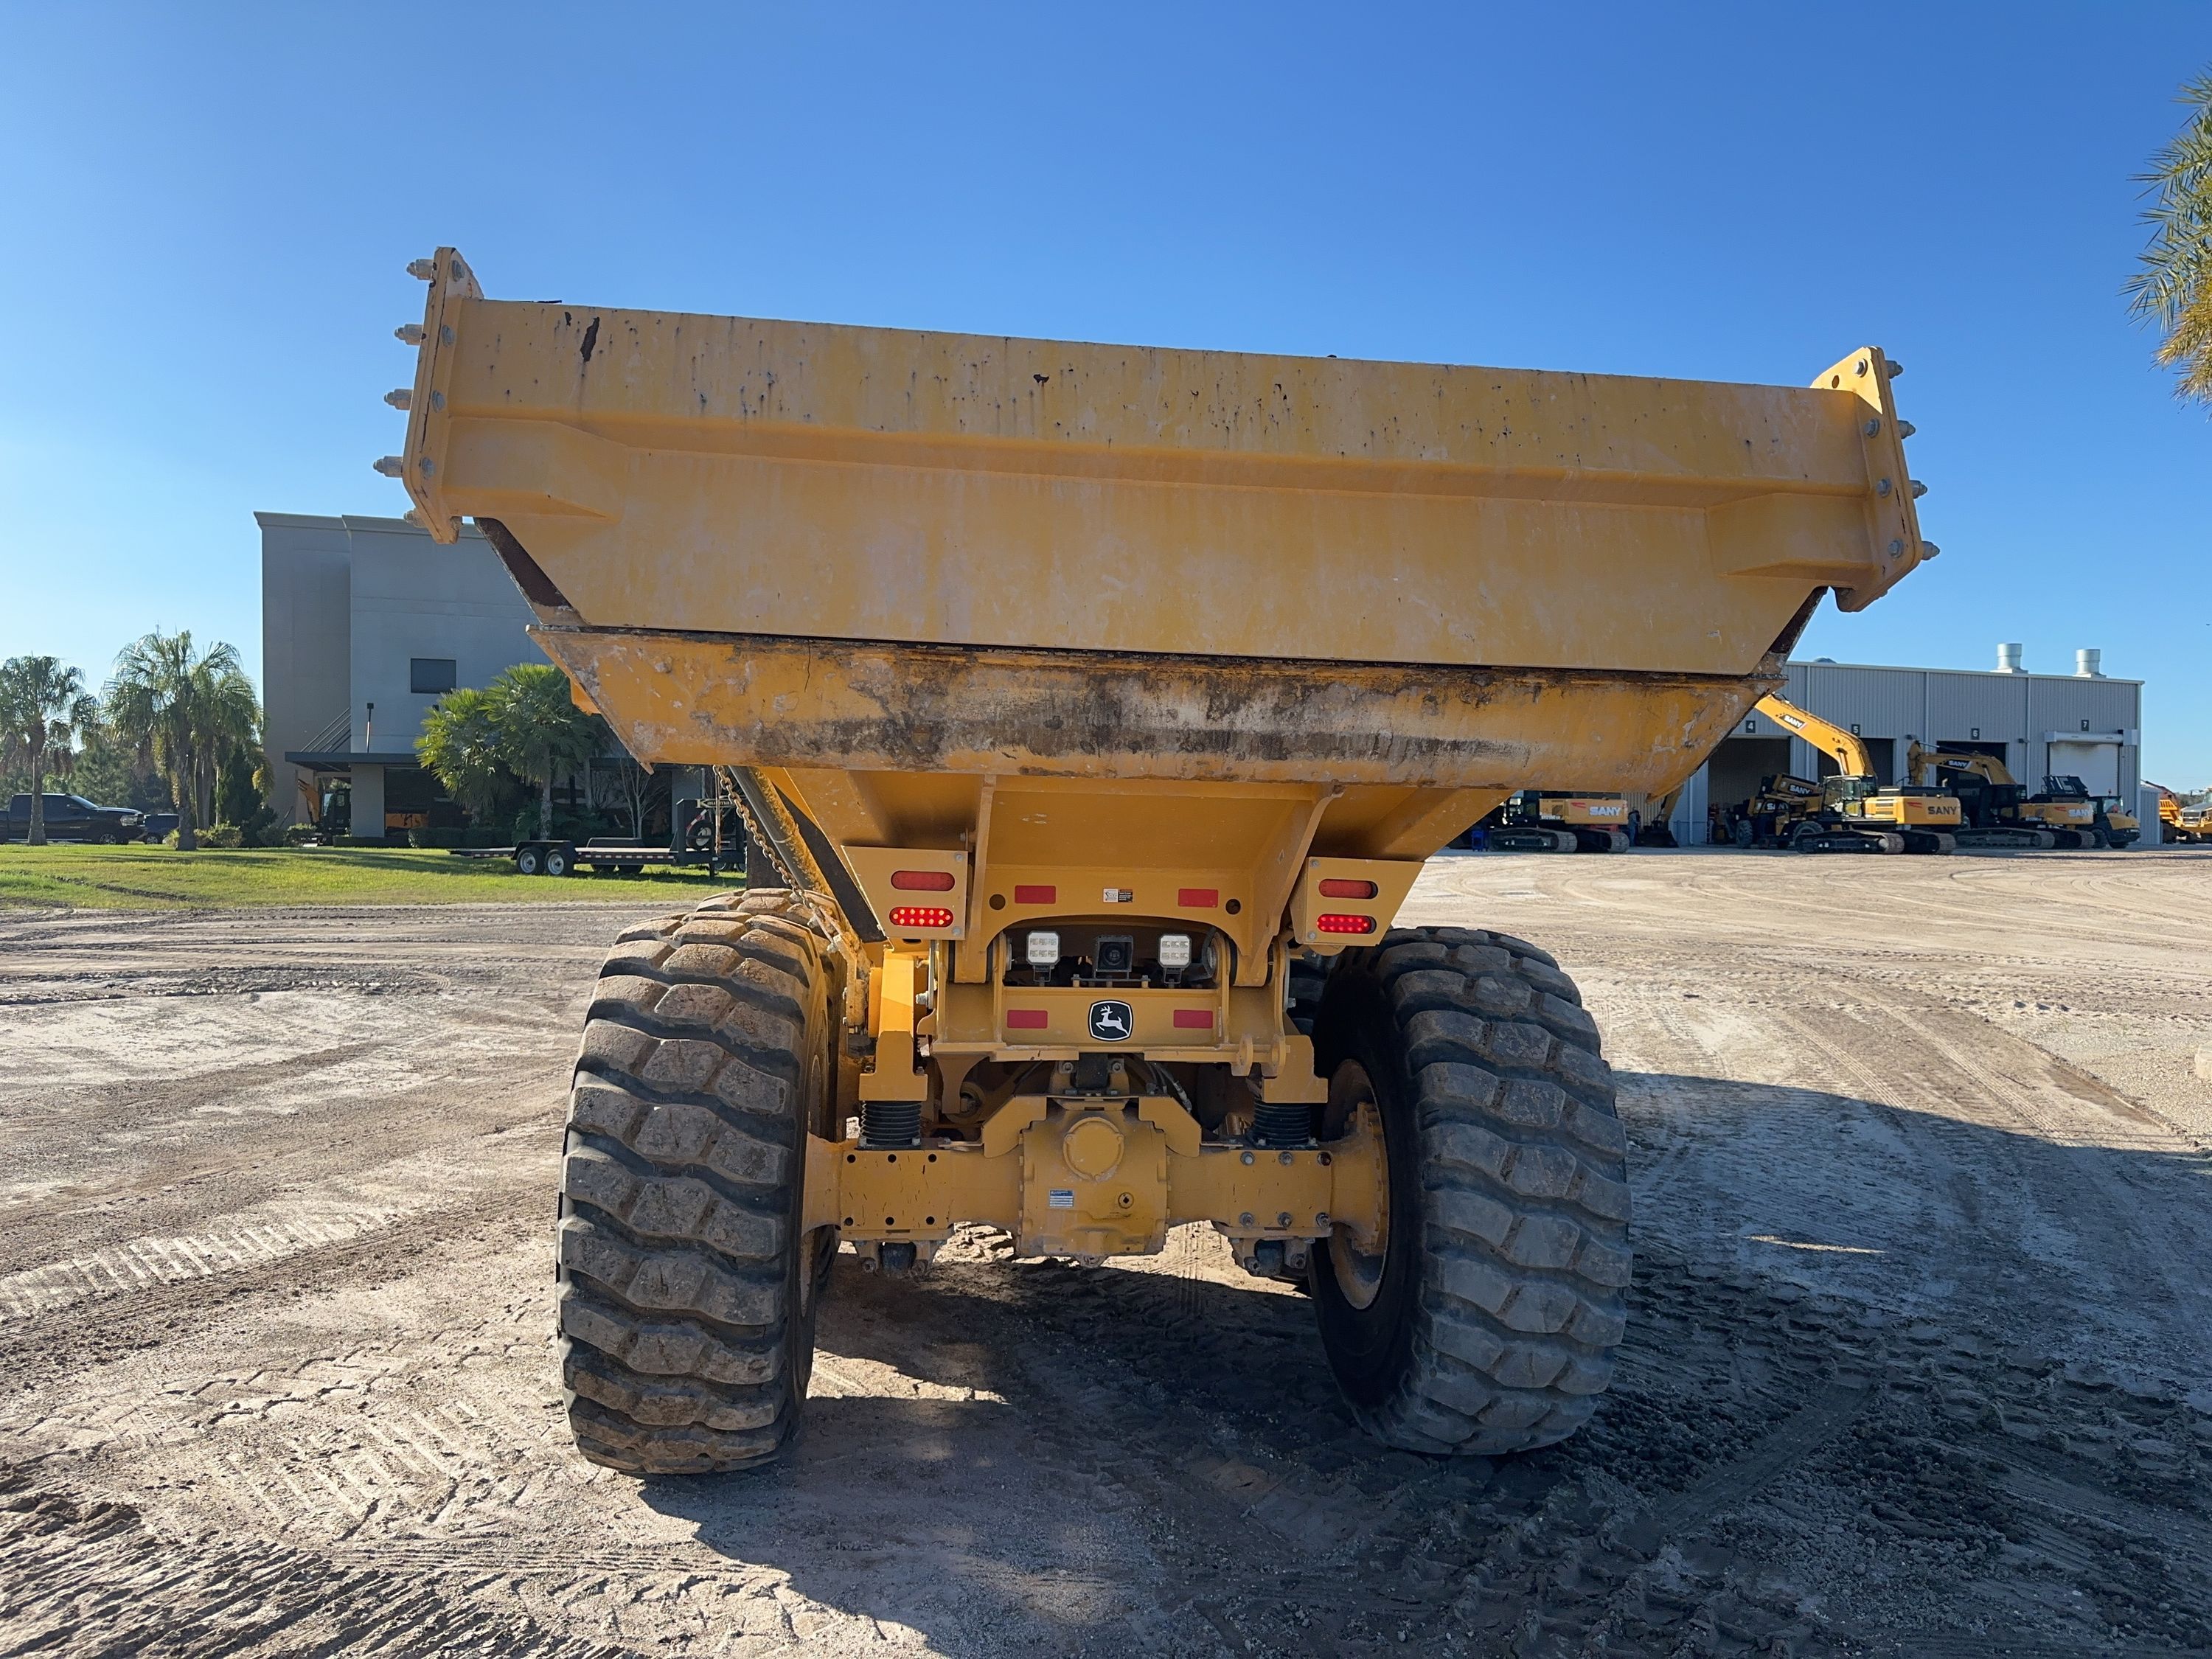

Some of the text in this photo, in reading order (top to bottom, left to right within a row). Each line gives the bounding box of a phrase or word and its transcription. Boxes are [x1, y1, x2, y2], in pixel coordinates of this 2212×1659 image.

[1784, 714, 1803, 728] SANY
[1748, 722, 1754, 730] 4
[1853, 726, 1859, 734] 5
[1789, 785, 1811, 794] SANY
[1589, 807, 1621, 816] SANY
[1927, 807, 1958, 815] SANY
